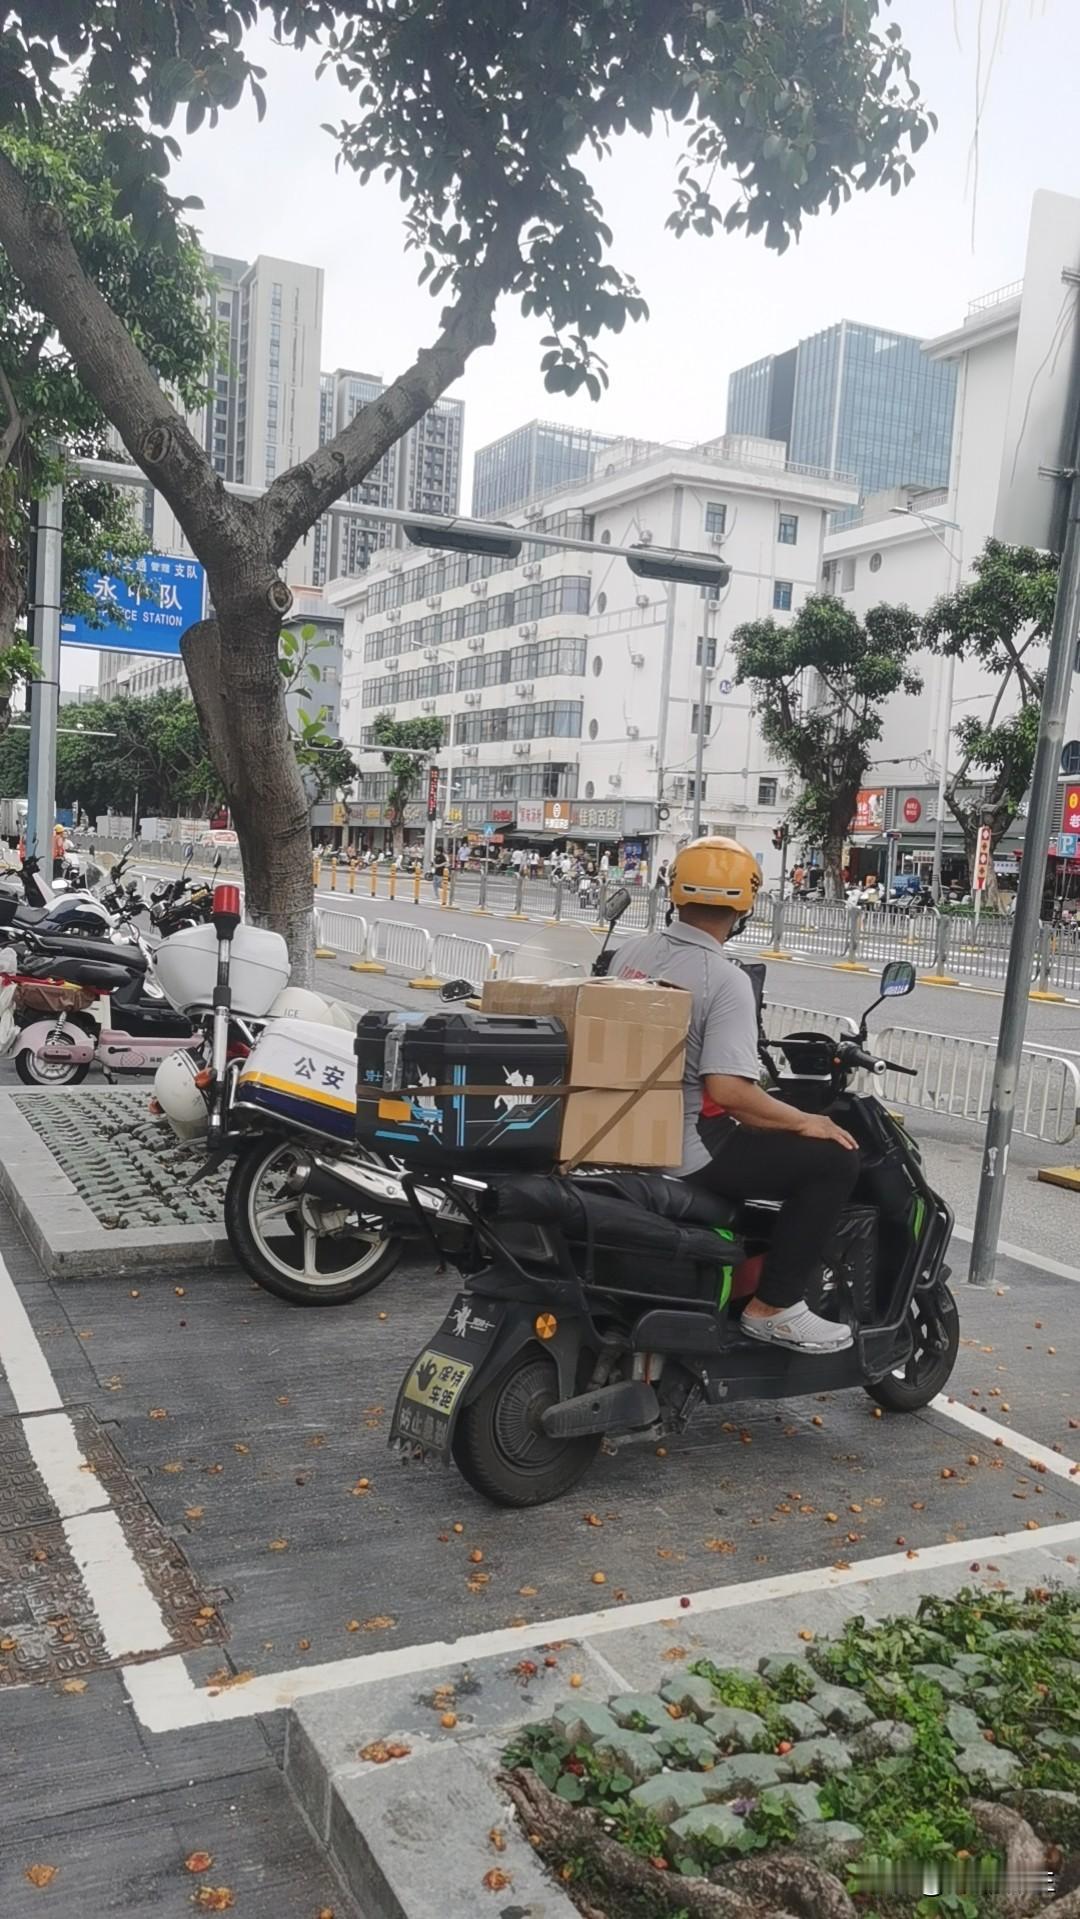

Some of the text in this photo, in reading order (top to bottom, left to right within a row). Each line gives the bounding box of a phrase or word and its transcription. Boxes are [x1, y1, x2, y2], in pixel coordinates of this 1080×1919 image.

[142, 611, 182, 627] STATION
[1061, 835, 1074, 854] P
[294, 1056, 345, 1090] 公安
